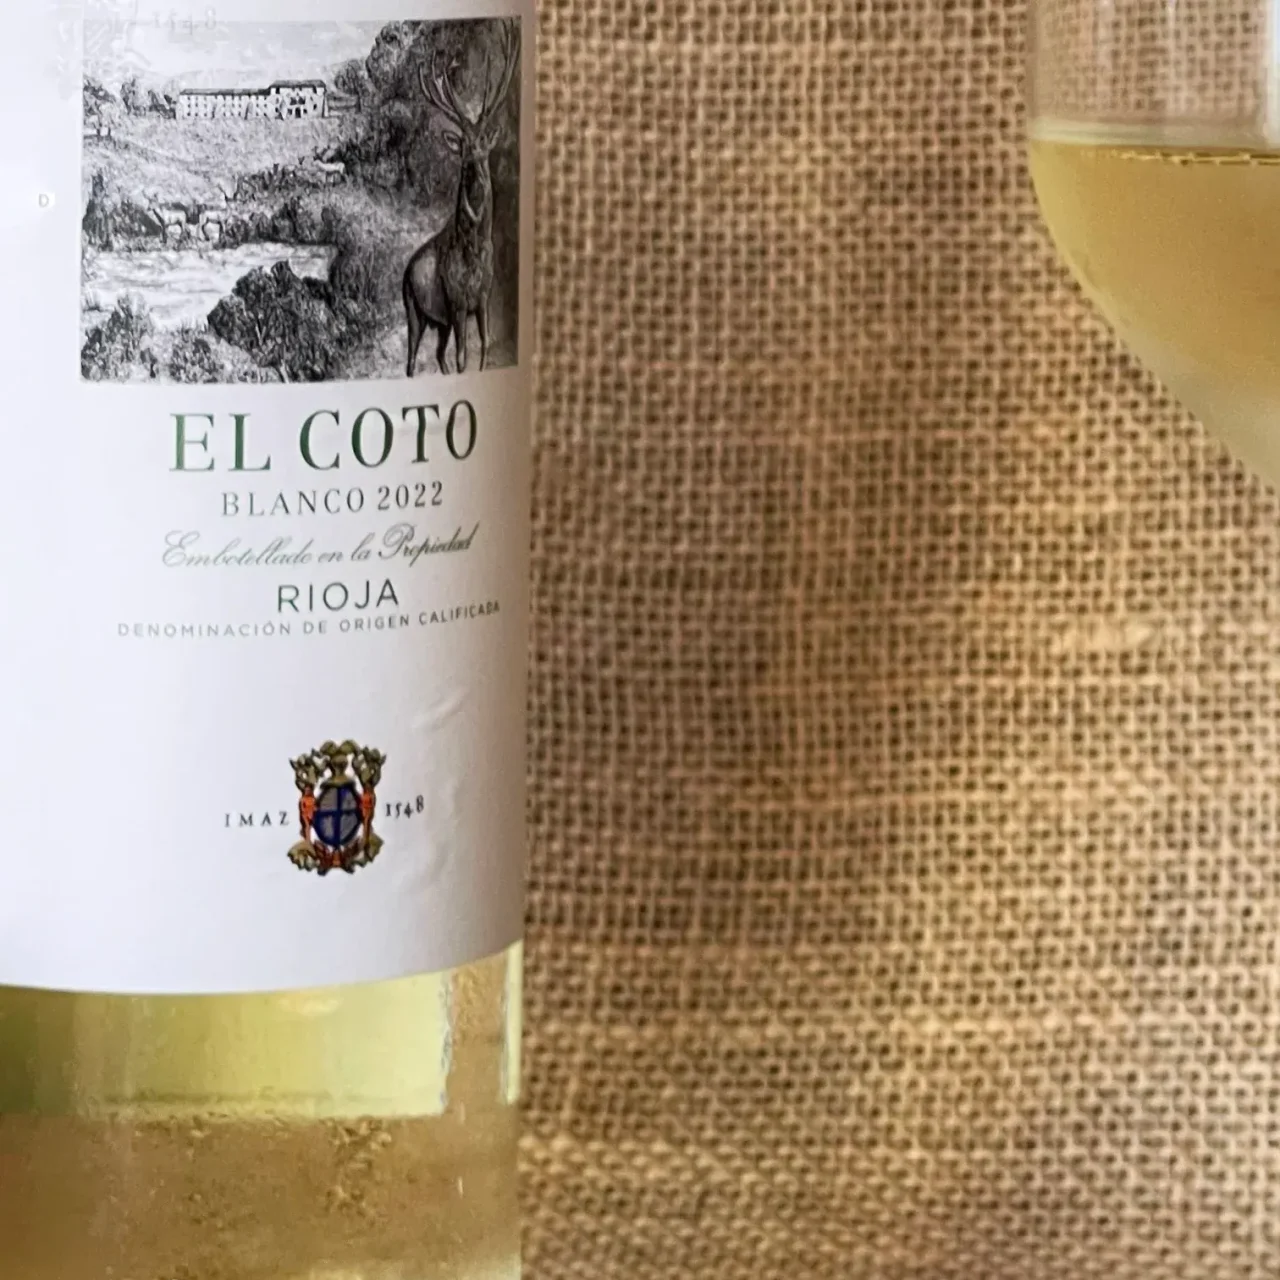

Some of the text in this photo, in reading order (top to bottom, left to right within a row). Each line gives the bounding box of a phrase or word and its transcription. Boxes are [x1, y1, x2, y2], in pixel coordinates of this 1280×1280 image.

[169, 399, 477, 472] EL COTO
[221, 480, 443, 516] BLANCO 2022
[161, 521, 481, 567] Embotellado en la Propiedad
[277, 578, 399, 612] RIOJA
[117, 600, 500, 637] DENOMINACIÓN DE ORIGEN CALIFICADA
[224, 794, 424, 828] IMAZ 1548
